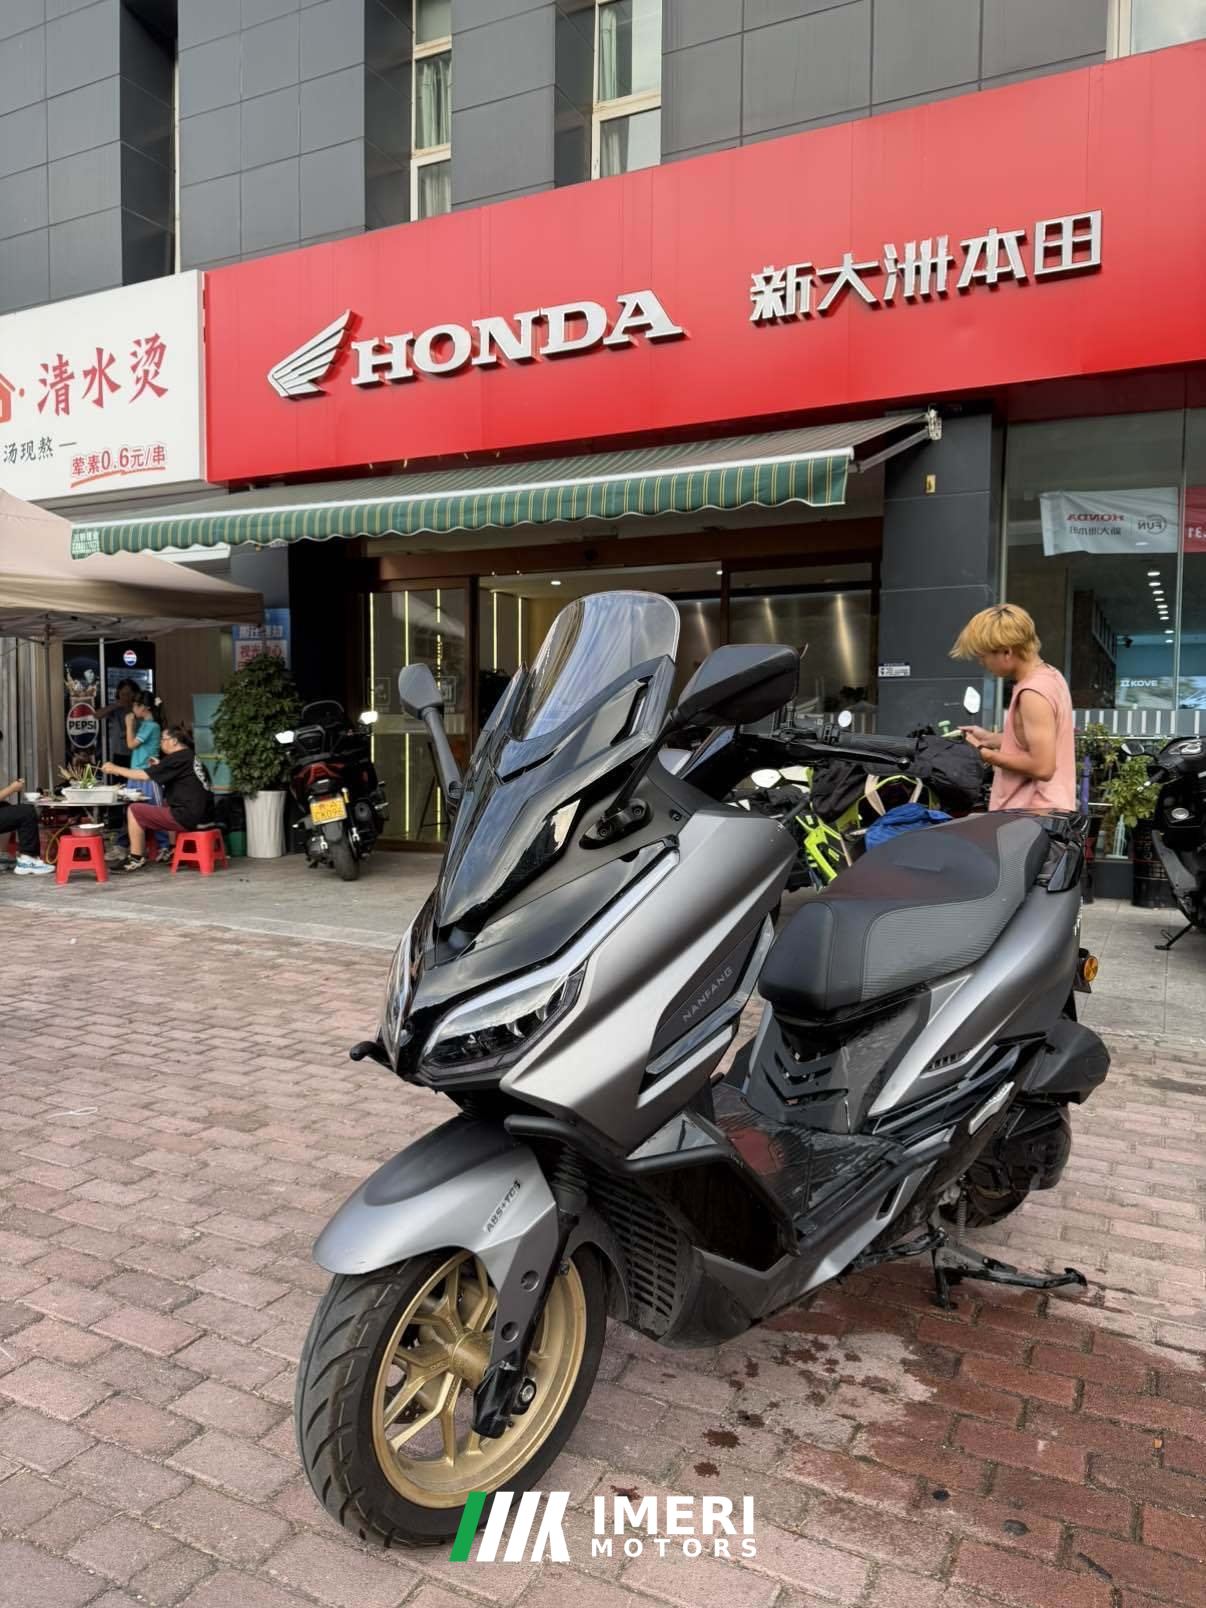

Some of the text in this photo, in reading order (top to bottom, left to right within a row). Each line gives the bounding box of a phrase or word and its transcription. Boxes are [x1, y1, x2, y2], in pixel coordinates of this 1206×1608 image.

[750, 210, 1102, 322] 新大洲本田
[37, 333, 168, 416] 清水烫
[350, 289, 684, 386] HONDA
[68, 720, 97, 730] PEPSI
[682, 967, 733, 1023] NANFANG
